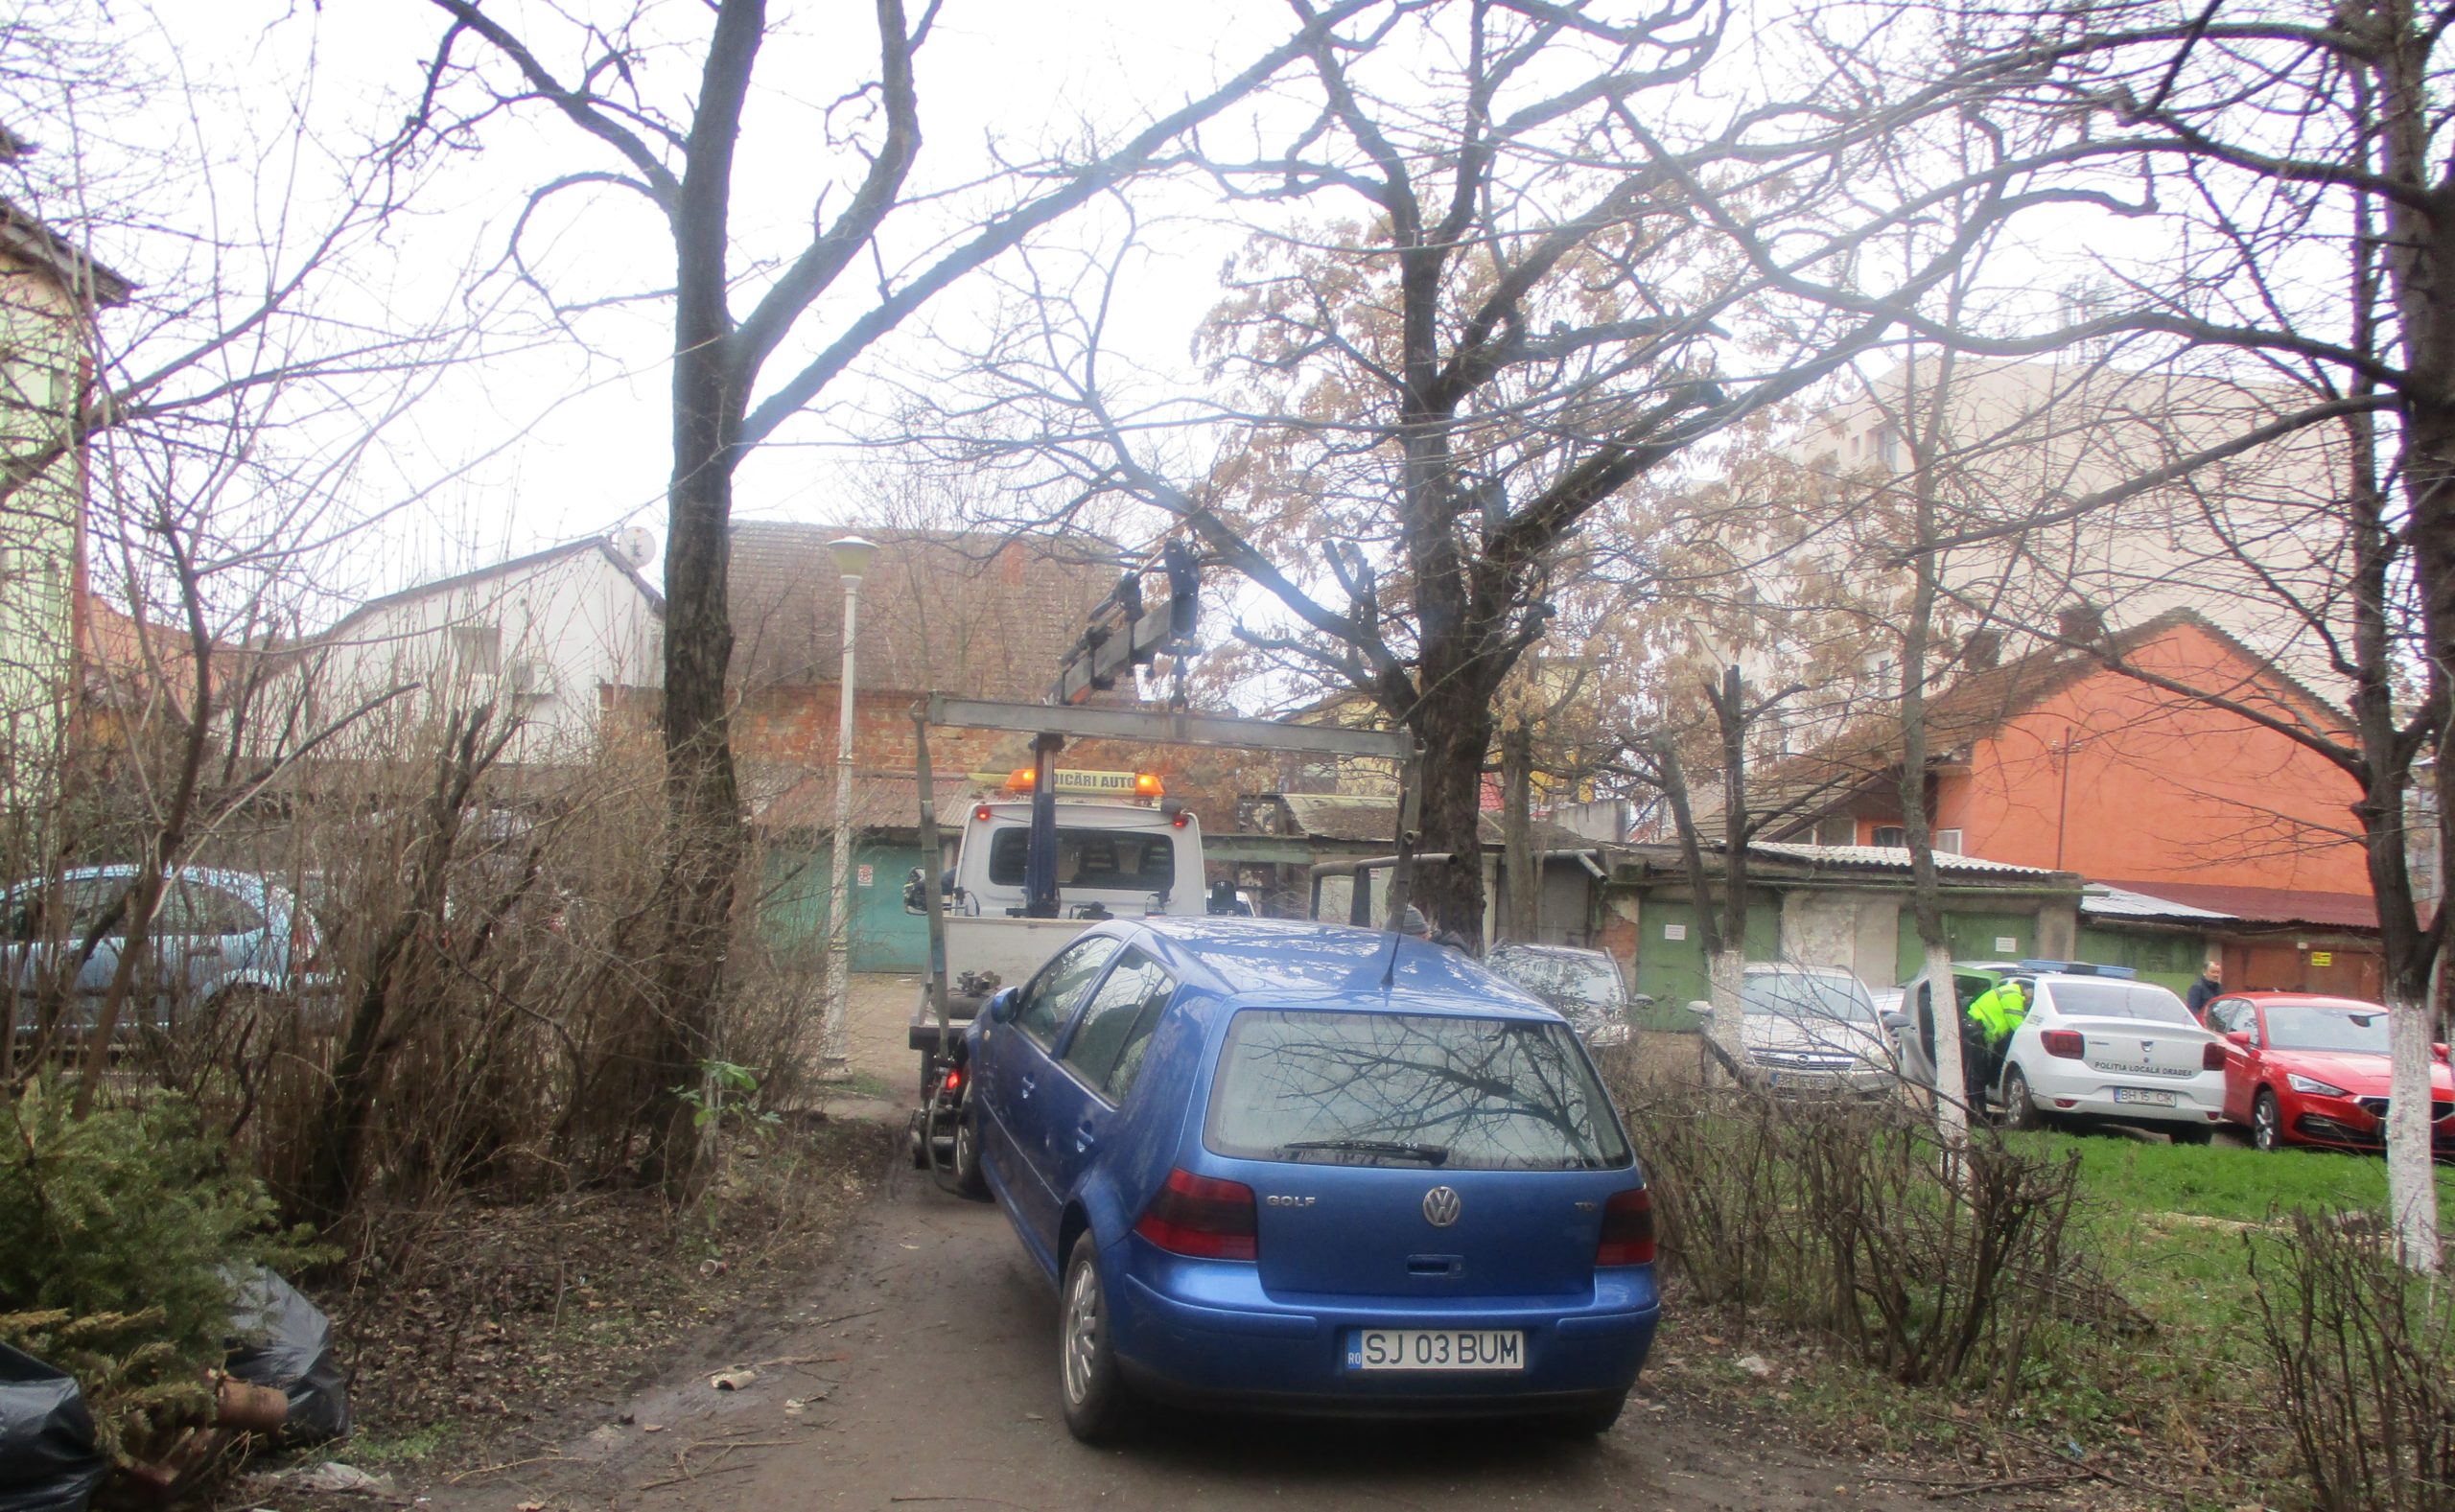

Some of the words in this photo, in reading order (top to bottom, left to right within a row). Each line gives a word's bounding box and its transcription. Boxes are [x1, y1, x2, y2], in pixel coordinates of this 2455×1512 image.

[1101, 776, 1135, 788] AUTO
[2121, 1089, 2137, 1100] BH
[1266, 1195, 1316, 1206] GOLF
[1366, 1333, 1403, 1364] SJ
[1415, 1334, 1450, 1364] 03
[1458, 1334, 1517, 1364] BUM
[1347, 1352, 1361, 1364] RO
